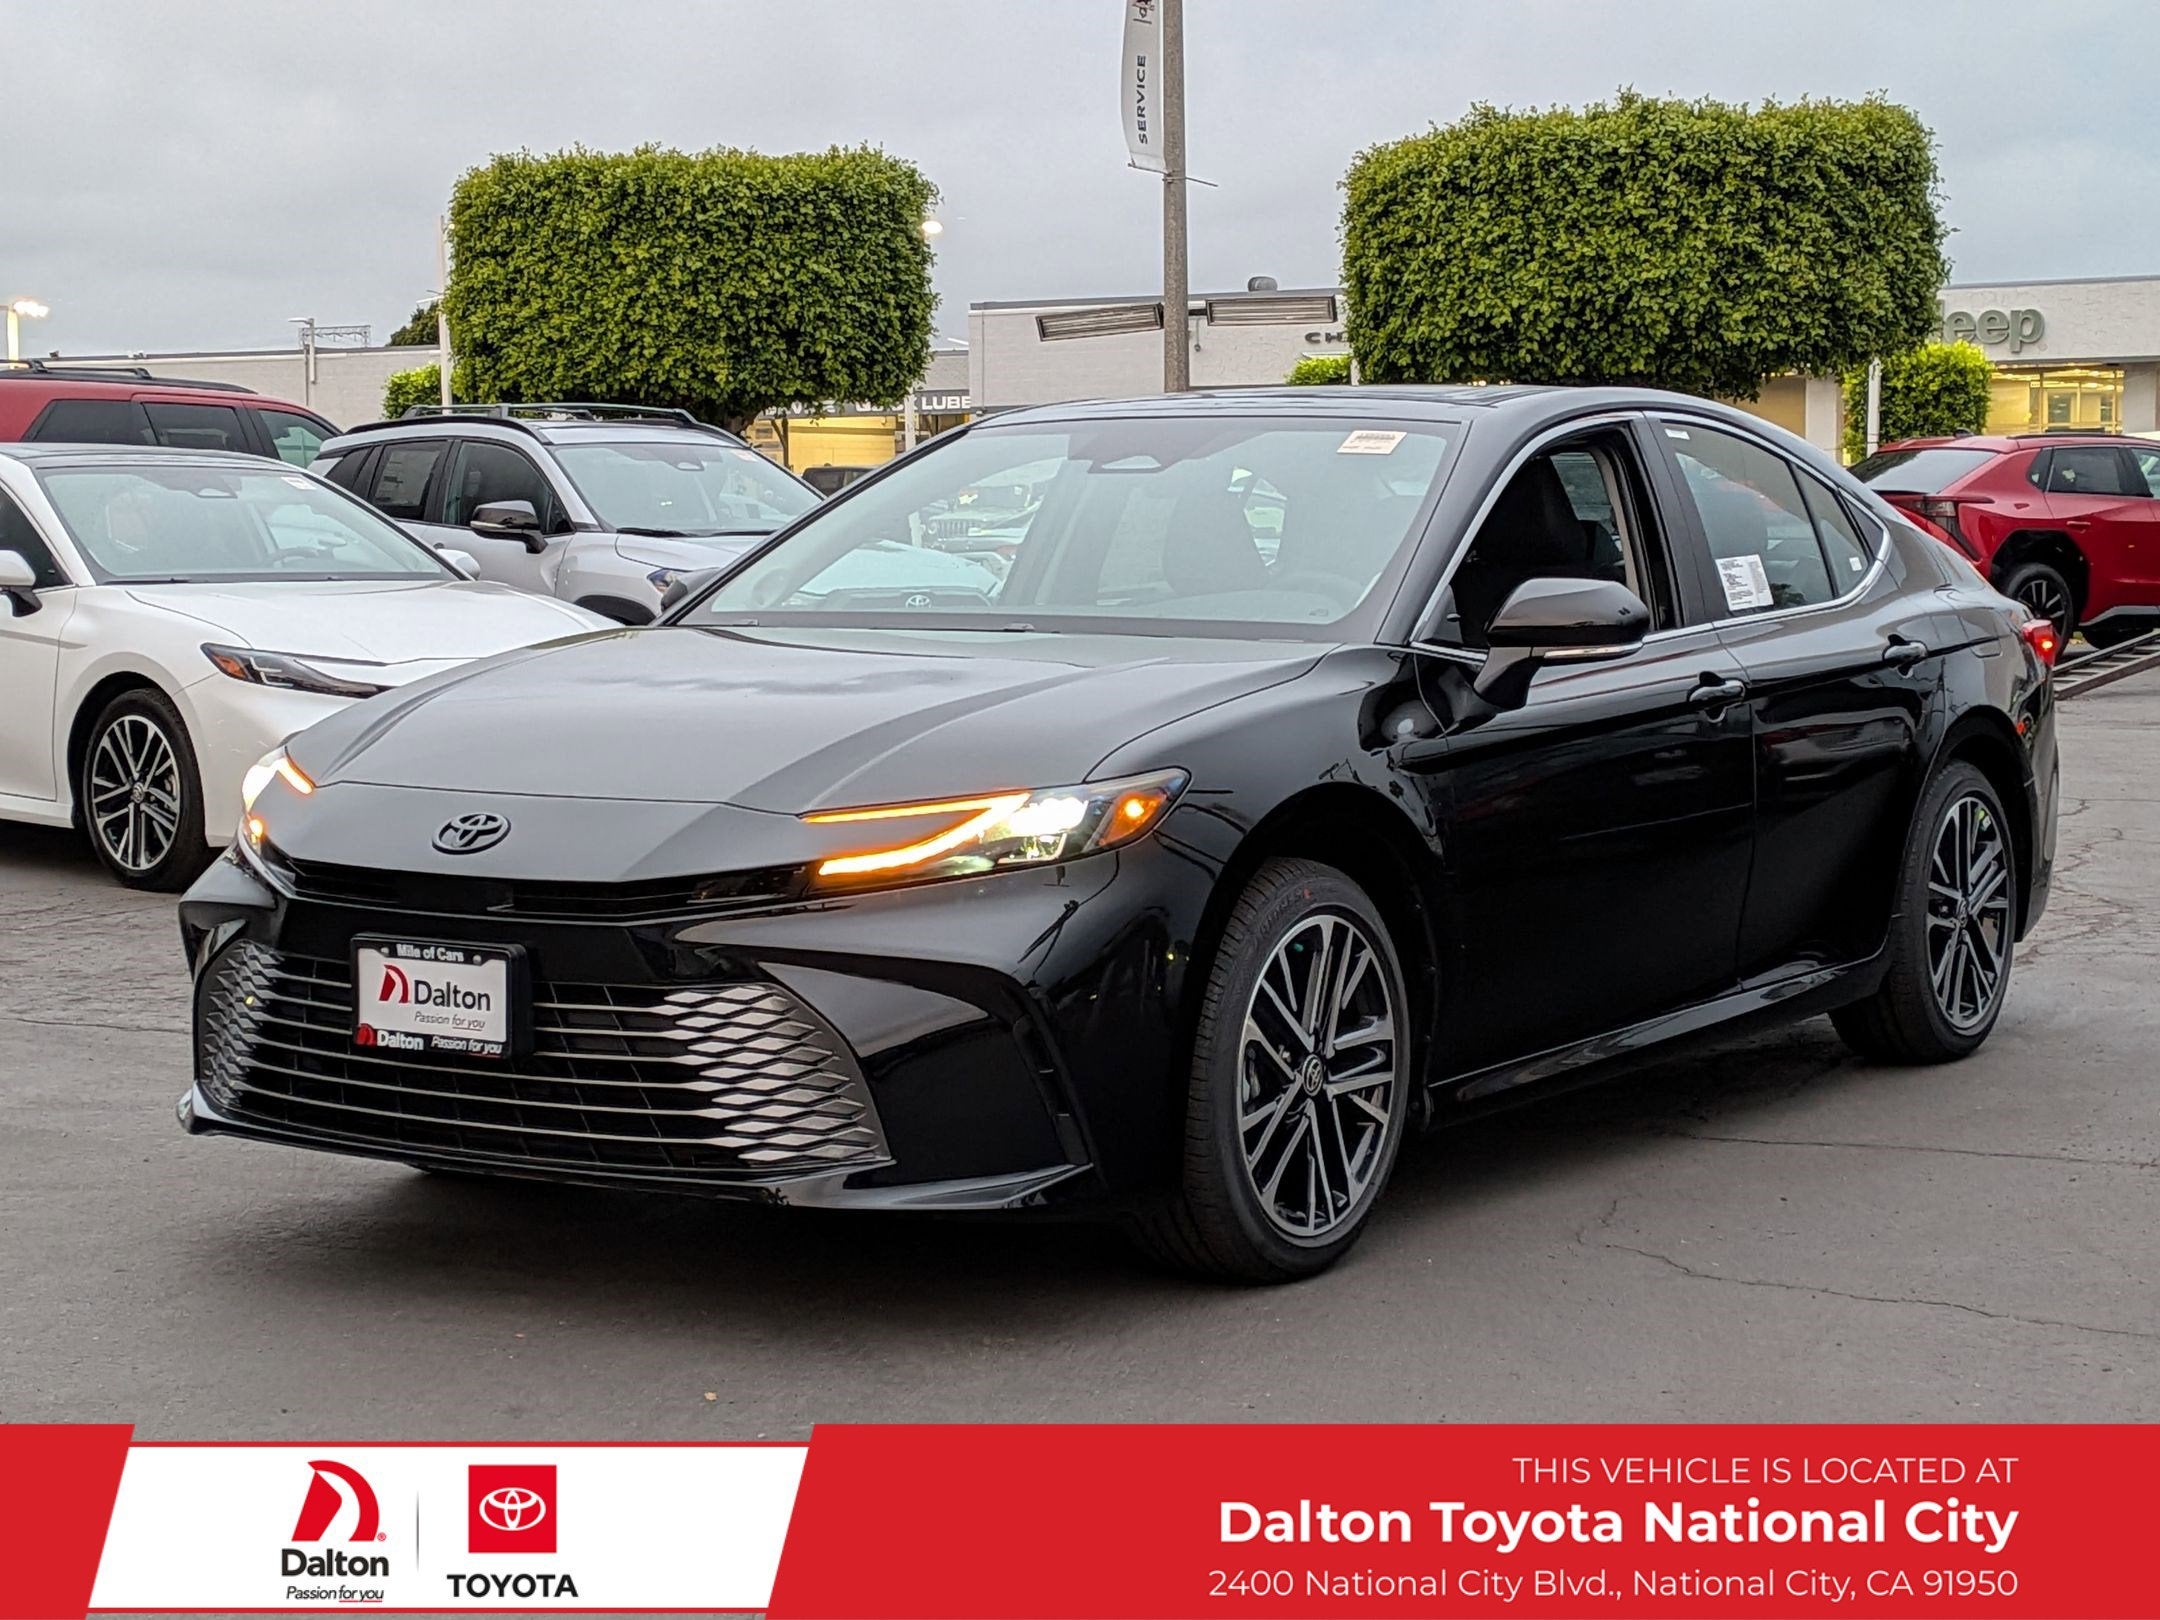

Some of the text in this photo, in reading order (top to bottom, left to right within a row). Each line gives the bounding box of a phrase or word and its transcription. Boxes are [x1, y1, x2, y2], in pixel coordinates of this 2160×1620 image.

[1136, 55, 1148, 145] SERVICE
[1941, 301, 2046, 353] eep
[921, 395, 972, 411] LUBE
[396, 944, 464, 962] Mile of Cars
[414, 979, 491, 1012] Dalton
[414, 1011, 486, 1029] Passion for you
[376, 1030, 502, 1055] Dalton Passion for you
